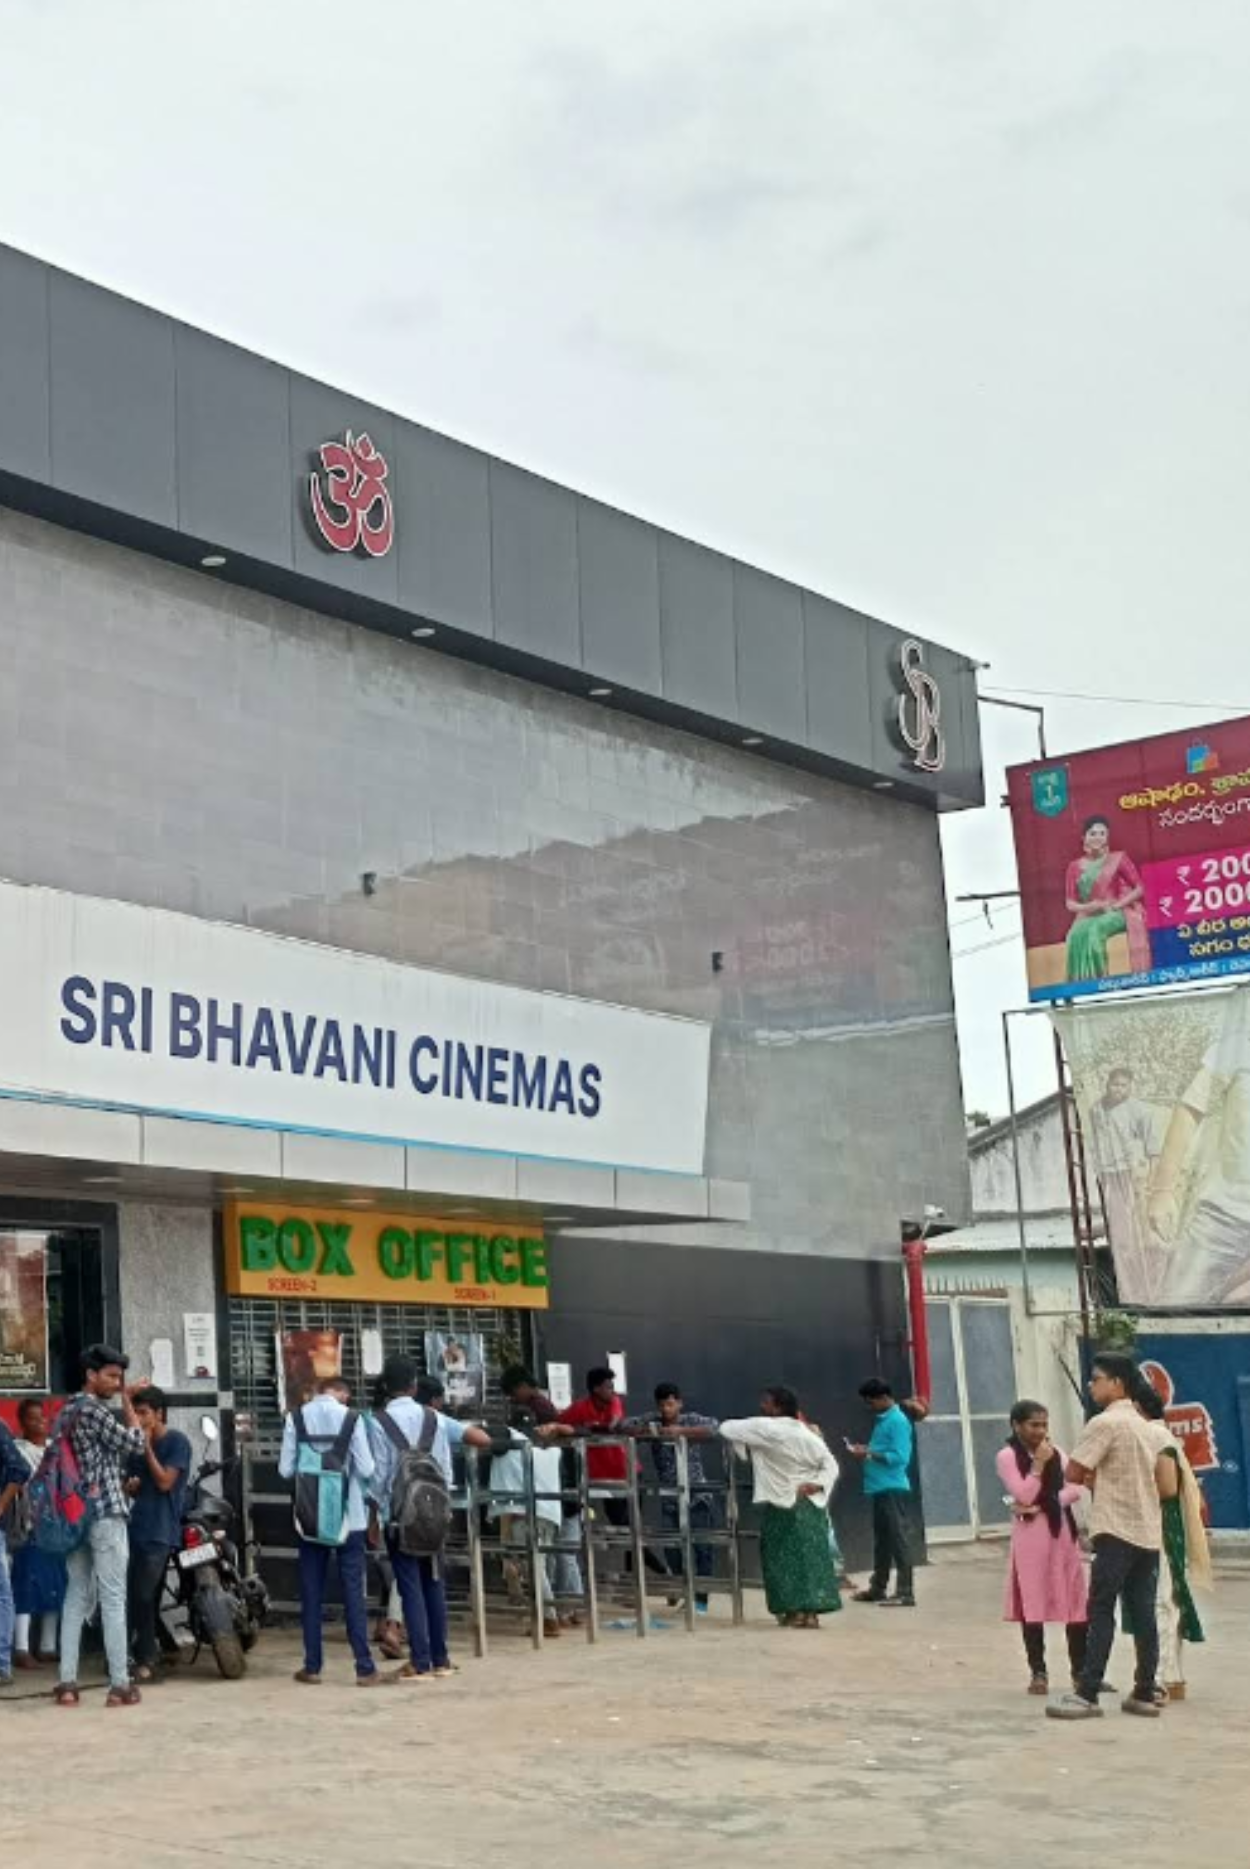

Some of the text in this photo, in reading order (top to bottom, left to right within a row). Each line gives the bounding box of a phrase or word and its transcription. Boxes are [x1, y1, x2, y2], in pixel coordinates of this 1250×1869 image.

[1184, 880, 1250, 914] 200
[60, 975, 602, 1118] SRI BHAVANI CINEMAS
[239, 1216, 549, 1287] BOX OFFICE
